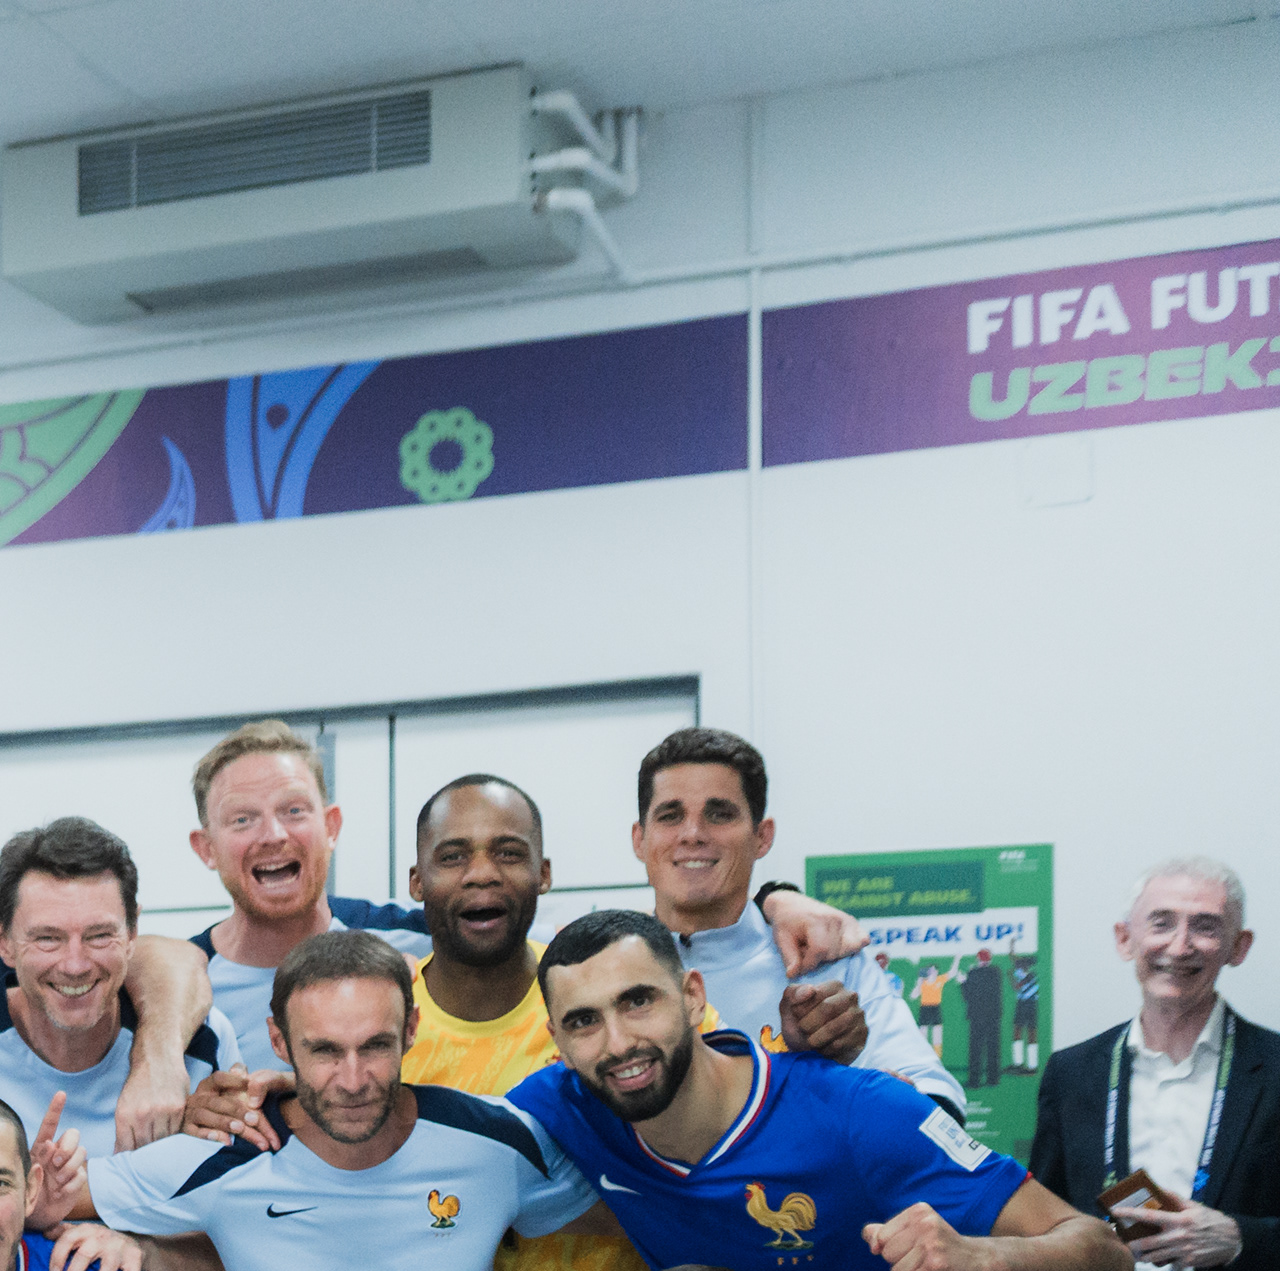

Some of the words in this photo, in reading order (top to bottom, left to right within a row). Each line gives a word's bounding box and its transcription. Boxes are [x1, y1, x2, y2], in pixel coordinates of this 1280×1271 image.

[967, 283, 1130, 354] FIFA
[869, 925, 963, 945] SPEAK
[975, 923, 1023, 942] UP!
